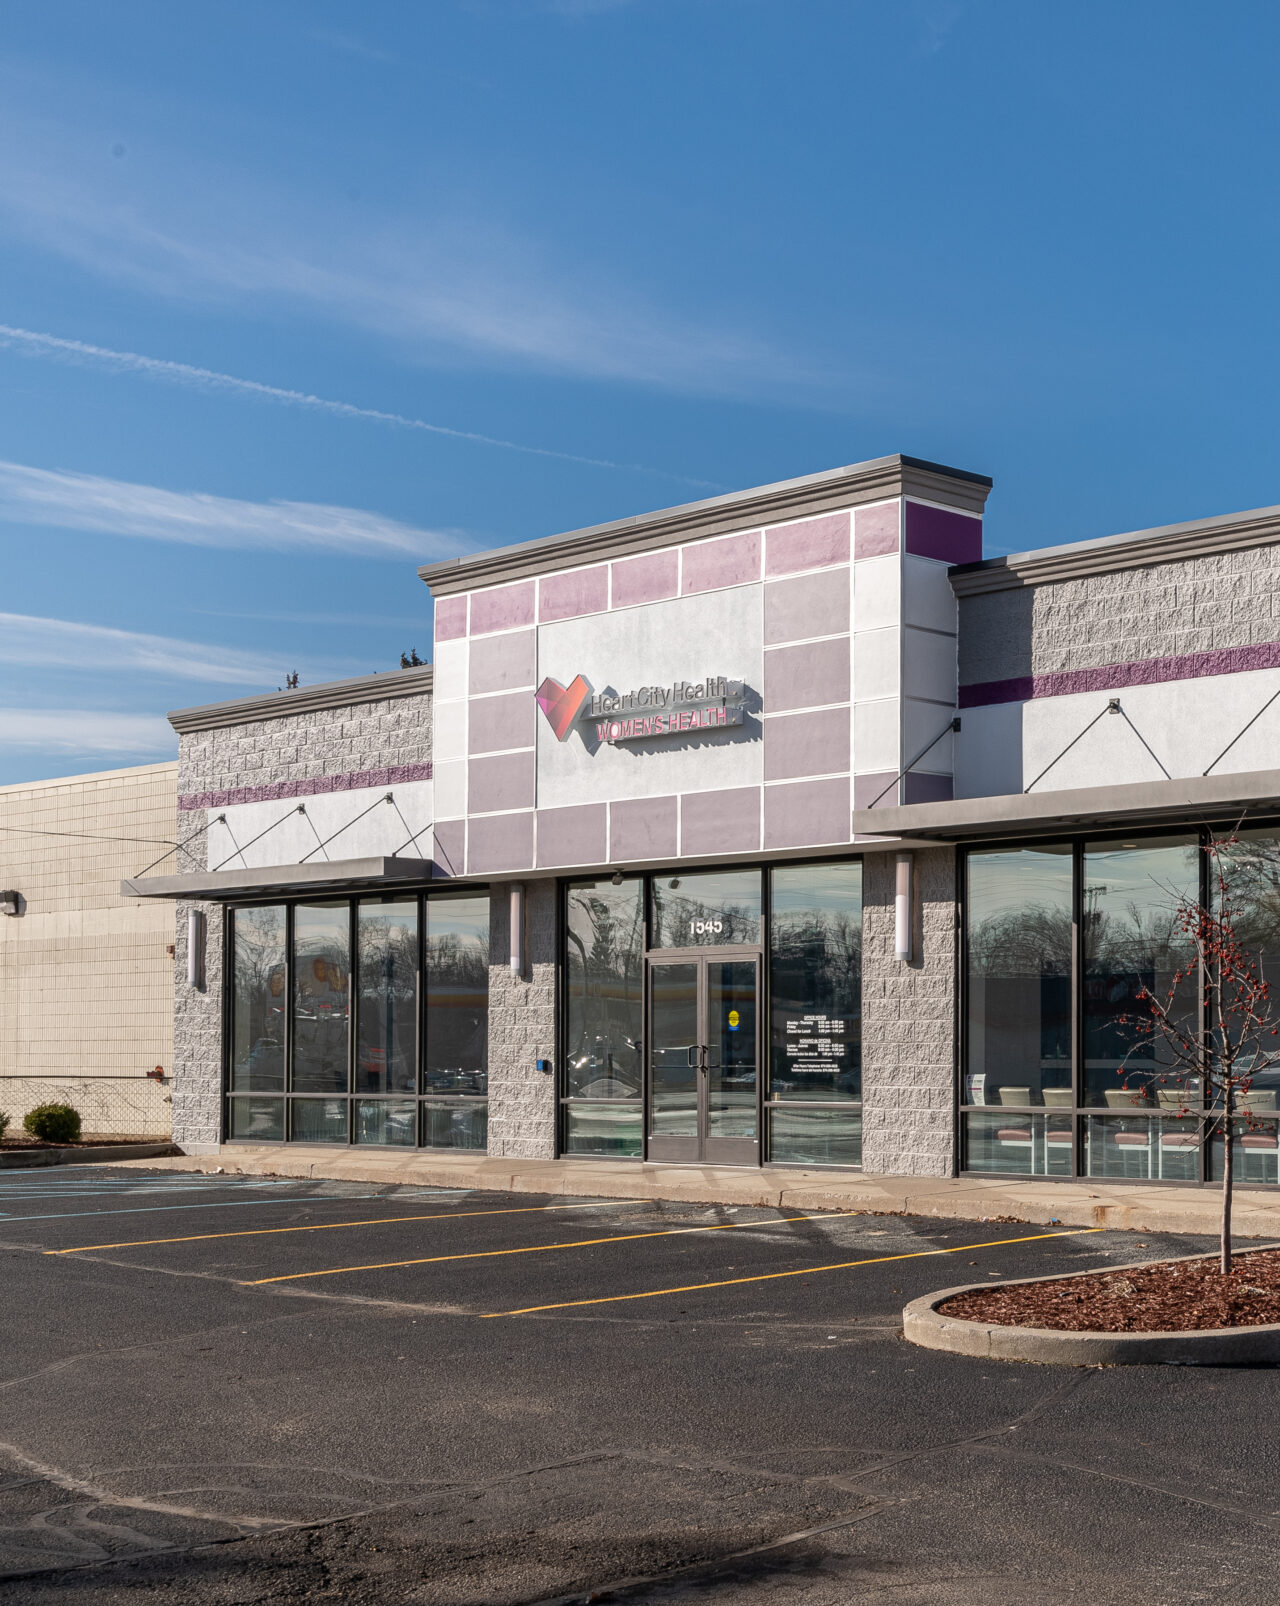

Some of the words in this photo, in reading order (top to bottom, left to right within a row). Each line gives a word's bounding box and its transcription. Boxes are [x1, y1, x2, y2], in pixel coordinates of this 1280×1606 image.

[591, 690, 635, 716] Heart
[637, 686, 671, 709] City
[673, 676, 727, 702] Health
[596, 715, 664, 741] WOMEN'S
[668, 706, 726, 731] HEALTH
[689, 920, 722, 934] 1545
